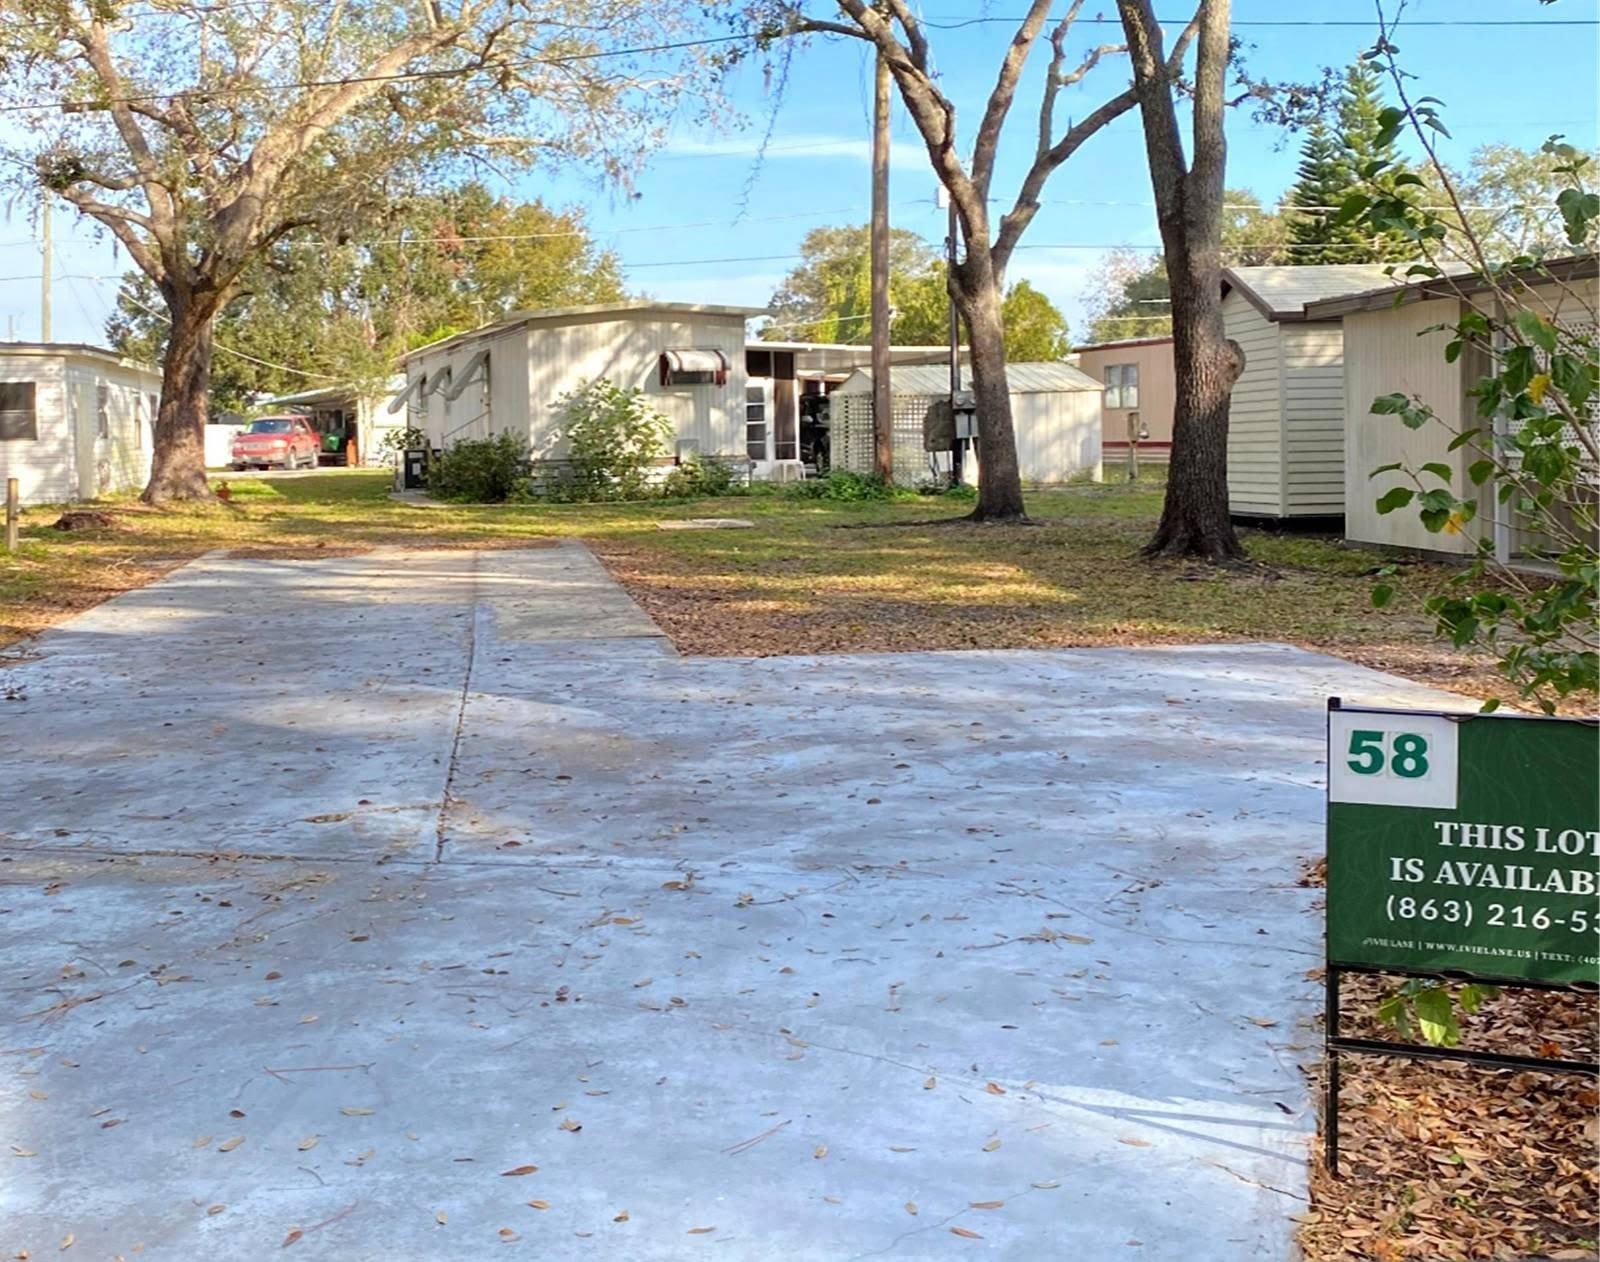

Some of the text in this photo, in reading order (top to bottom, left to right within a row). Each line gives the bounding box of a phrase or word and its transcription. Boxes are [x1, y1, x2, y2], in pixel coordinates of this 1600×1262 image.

[1347, 729, 1429, 779] 58
[1434, 821, 1525, 851] THIS
[1390, 857, 1600, 897] IS AVAILAB
[1386, 894, 1473, 927] (863)
